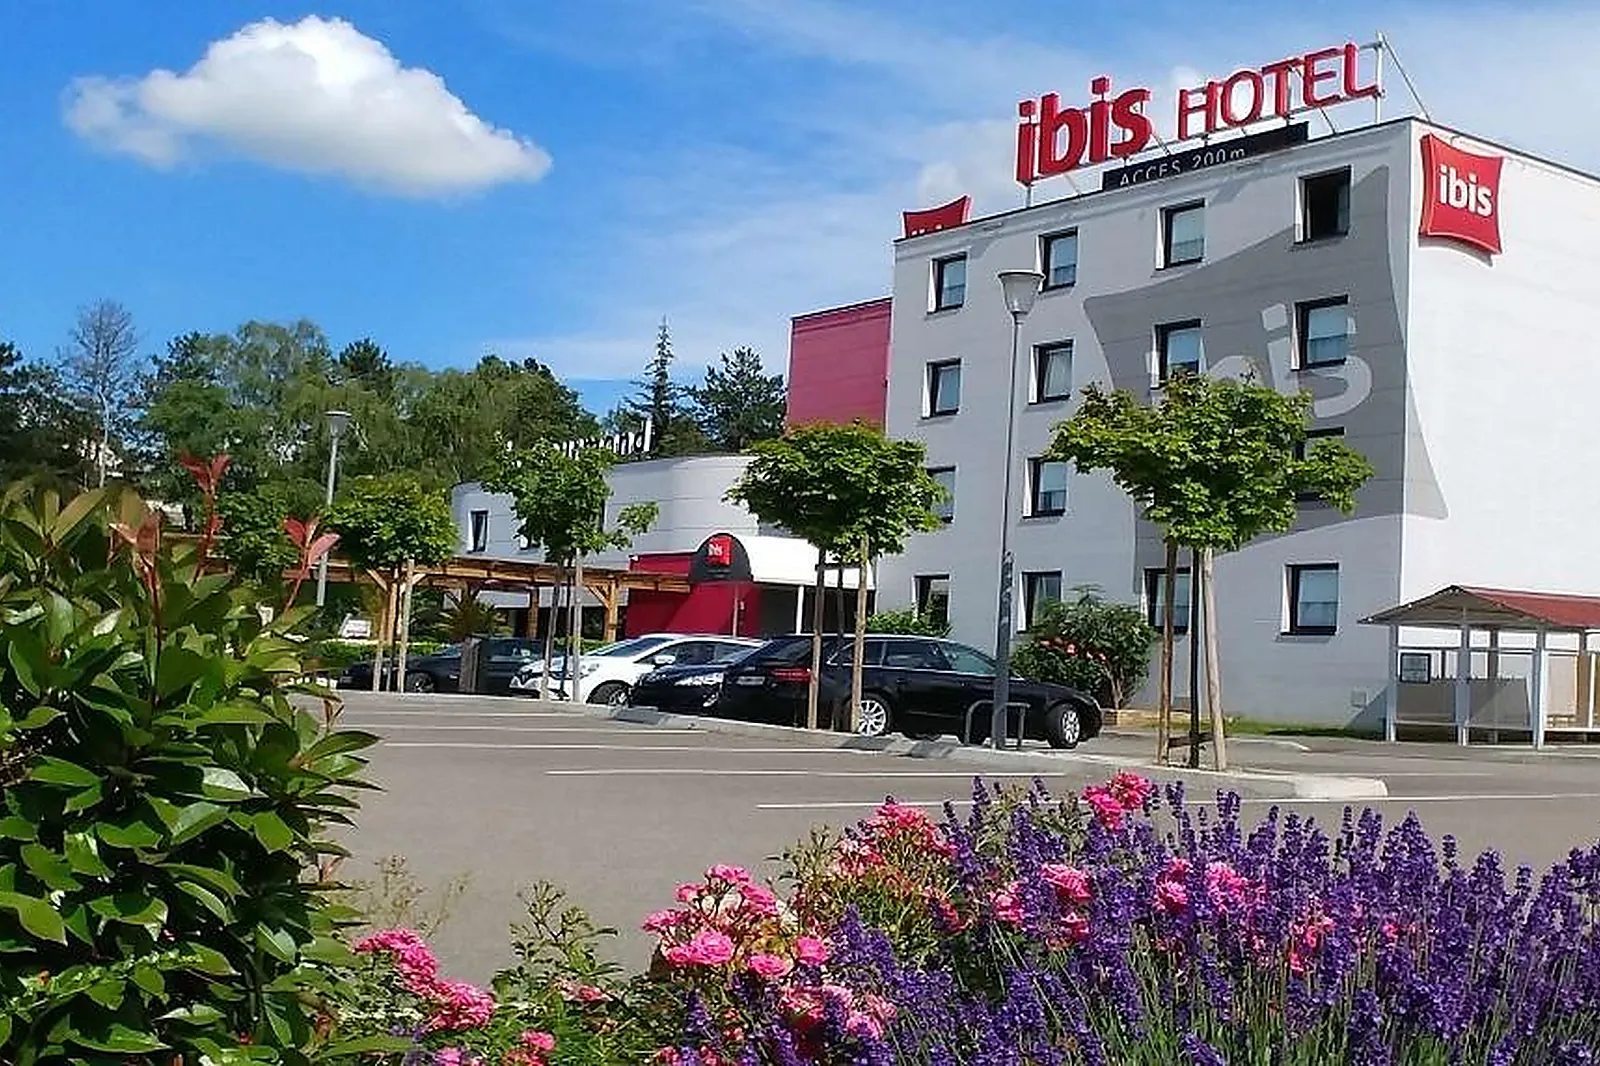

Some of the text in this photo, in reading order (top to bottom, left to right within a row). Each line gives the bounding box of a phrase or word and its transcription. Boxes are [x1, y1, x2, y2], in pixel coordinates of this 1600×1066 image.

[1016, 42, 1379, 186] ibis HOTEL
[1439, 163, 1492, 217] ibis
